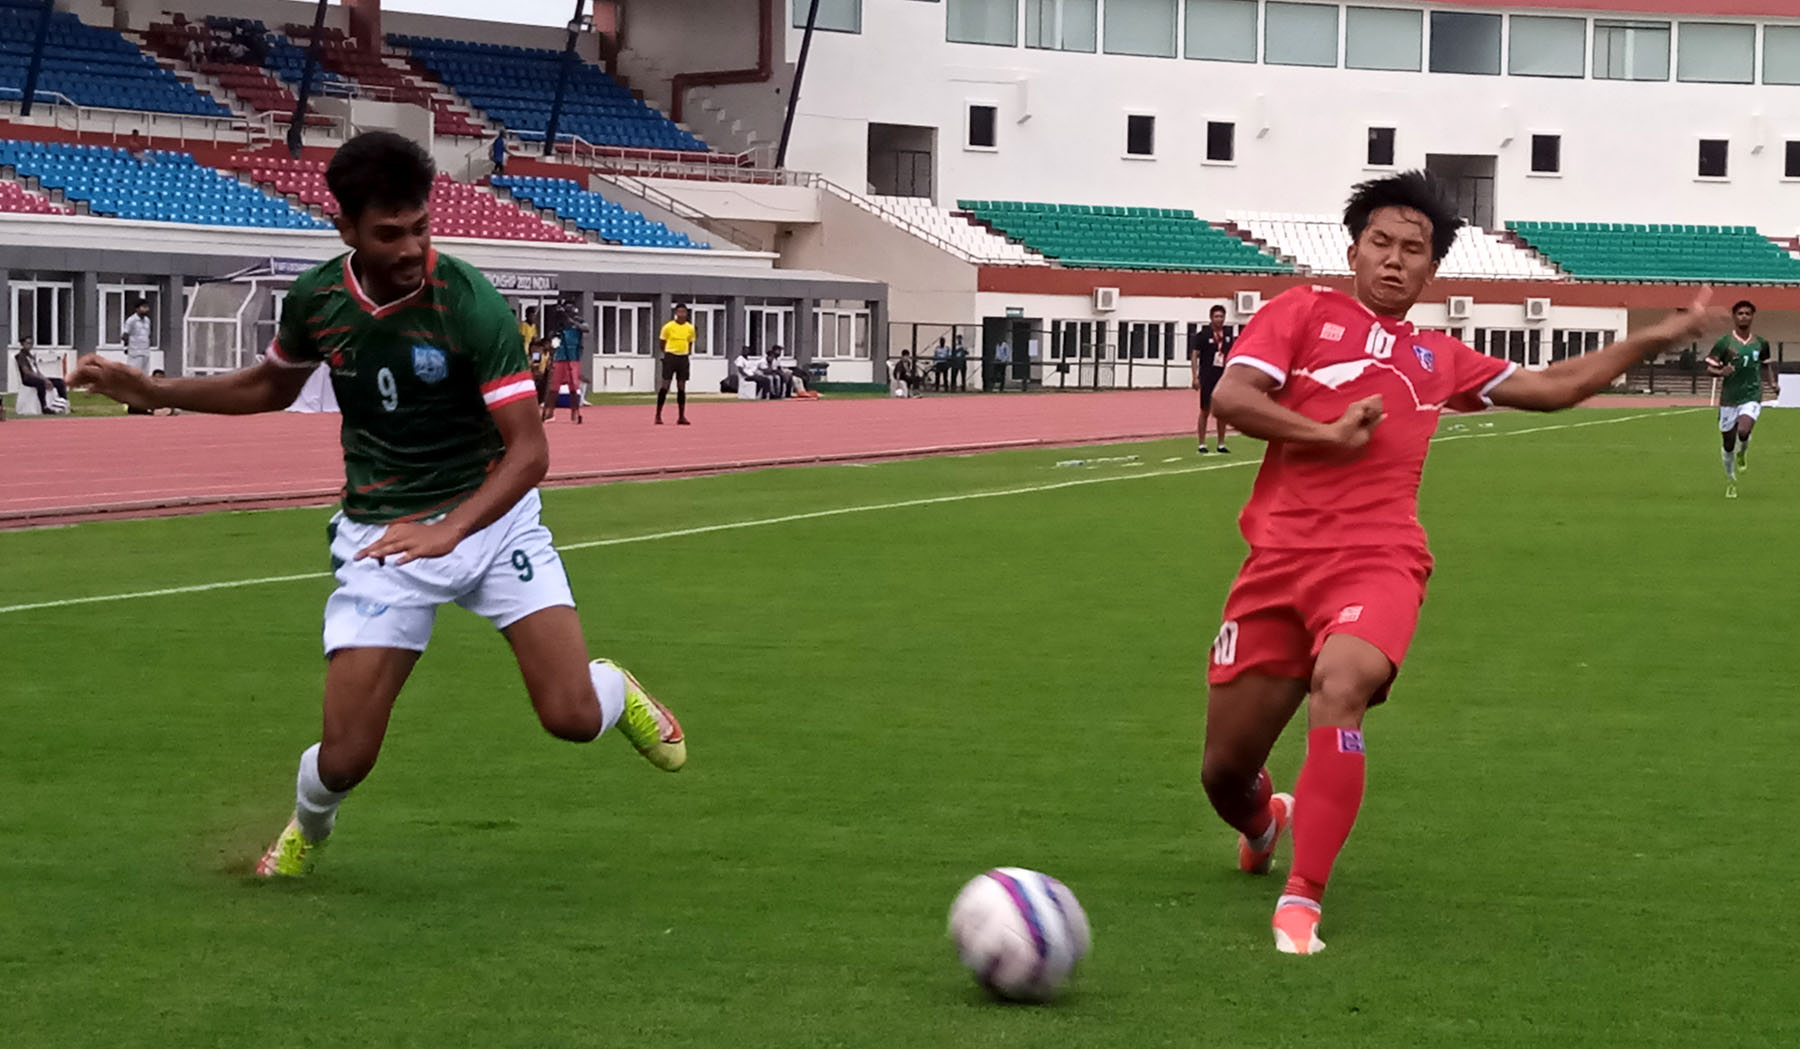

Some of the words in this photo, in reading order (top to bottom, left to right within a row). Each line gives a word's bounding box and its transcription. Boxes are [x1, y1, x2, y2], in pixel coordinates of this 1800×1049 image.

[1364, 320, 1397, 359] 10
[1742, 355, 1749, 367] 7
[377, 367, 398, 412] 9
[511, 549, 534, 582] 9
[1213, 620, 1239, 665] 10
